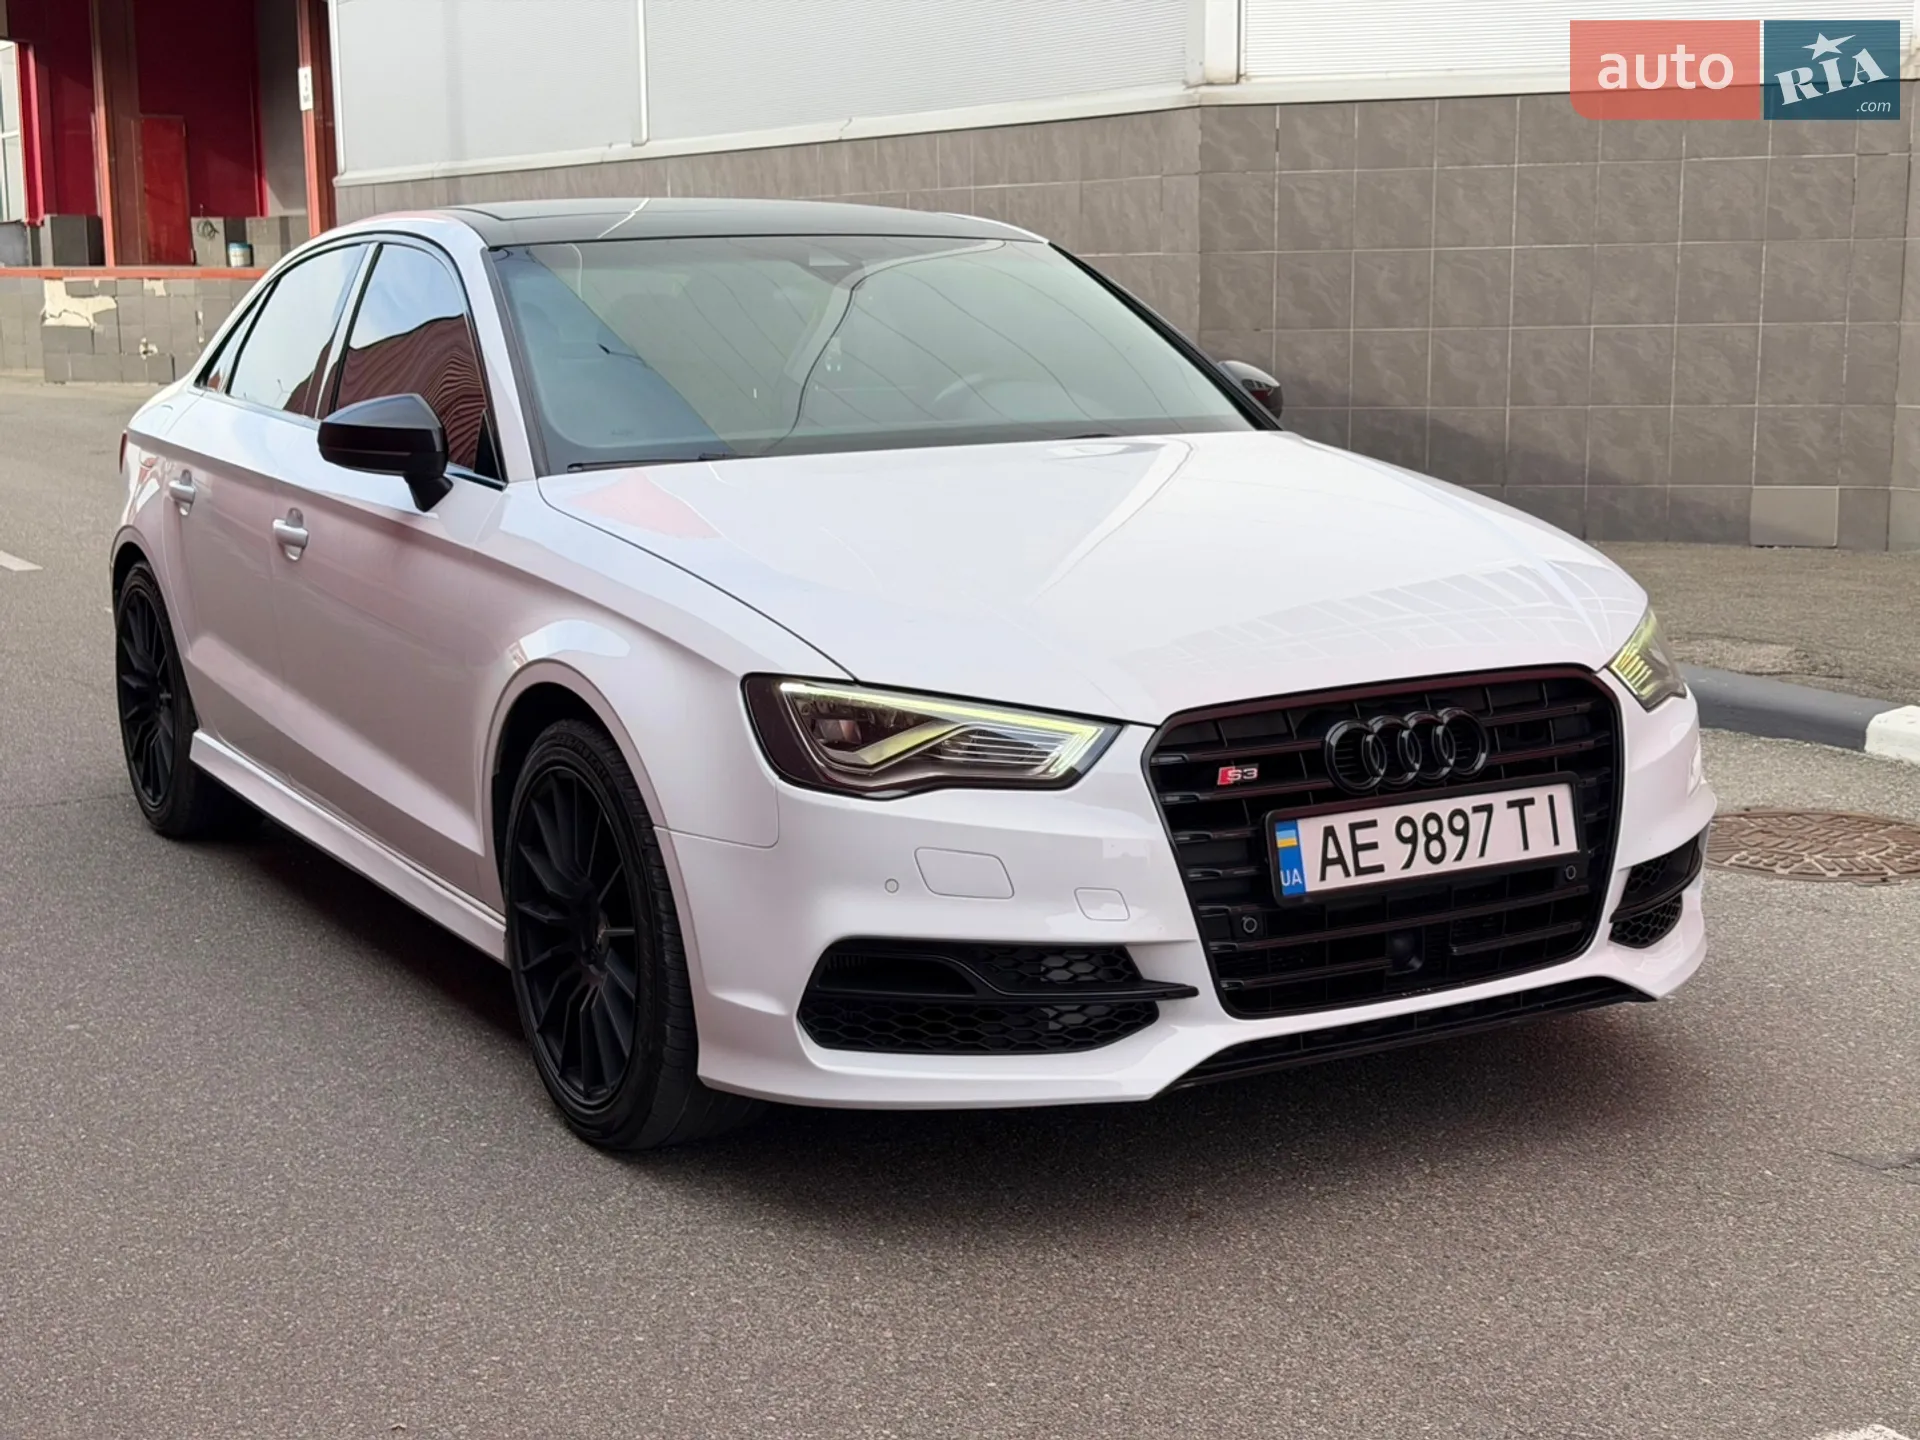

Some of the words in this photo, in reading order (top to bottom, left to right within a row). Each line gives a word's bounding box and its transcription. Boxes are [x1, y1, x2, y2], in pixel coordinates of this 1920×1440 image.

[1227, 767, 1258, 781] S3
[1319, 819, 1385, 882] AE
[1394, 803, 1494, 870] 9897
[1507, 794, 1560, 851] TI
[1280, 868, 1303, 887] UA
